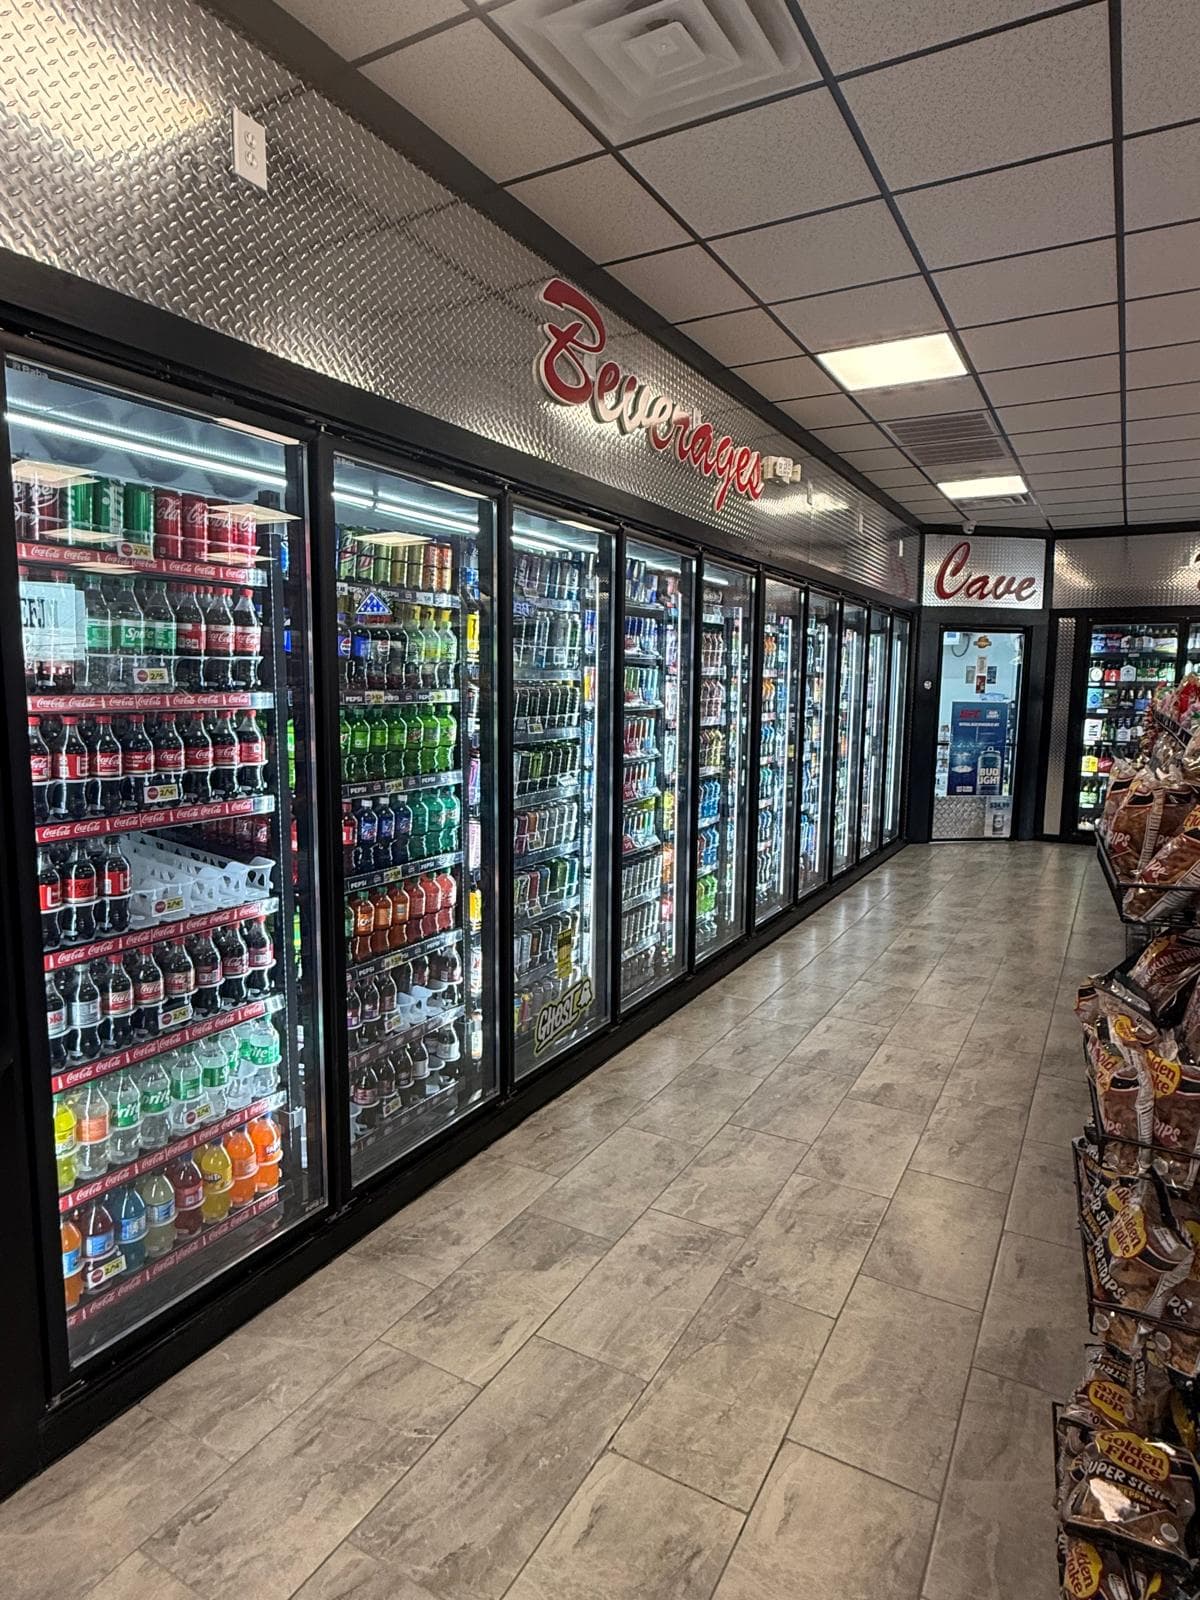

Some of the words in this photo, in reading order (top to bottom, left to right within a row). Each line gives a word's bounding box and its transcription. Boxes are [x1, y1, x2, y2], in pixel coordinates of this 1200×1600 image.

[539, 277, 763, 512] Beverages
[934, 541, 1037, 602] Cave
[980, 767, 999, 776] BUD
[537, 983, 583, 1044] GHOST
[1100, 1433, 1164, 1471] Golden
[1104, 1446, 1161, 1480] Flake
